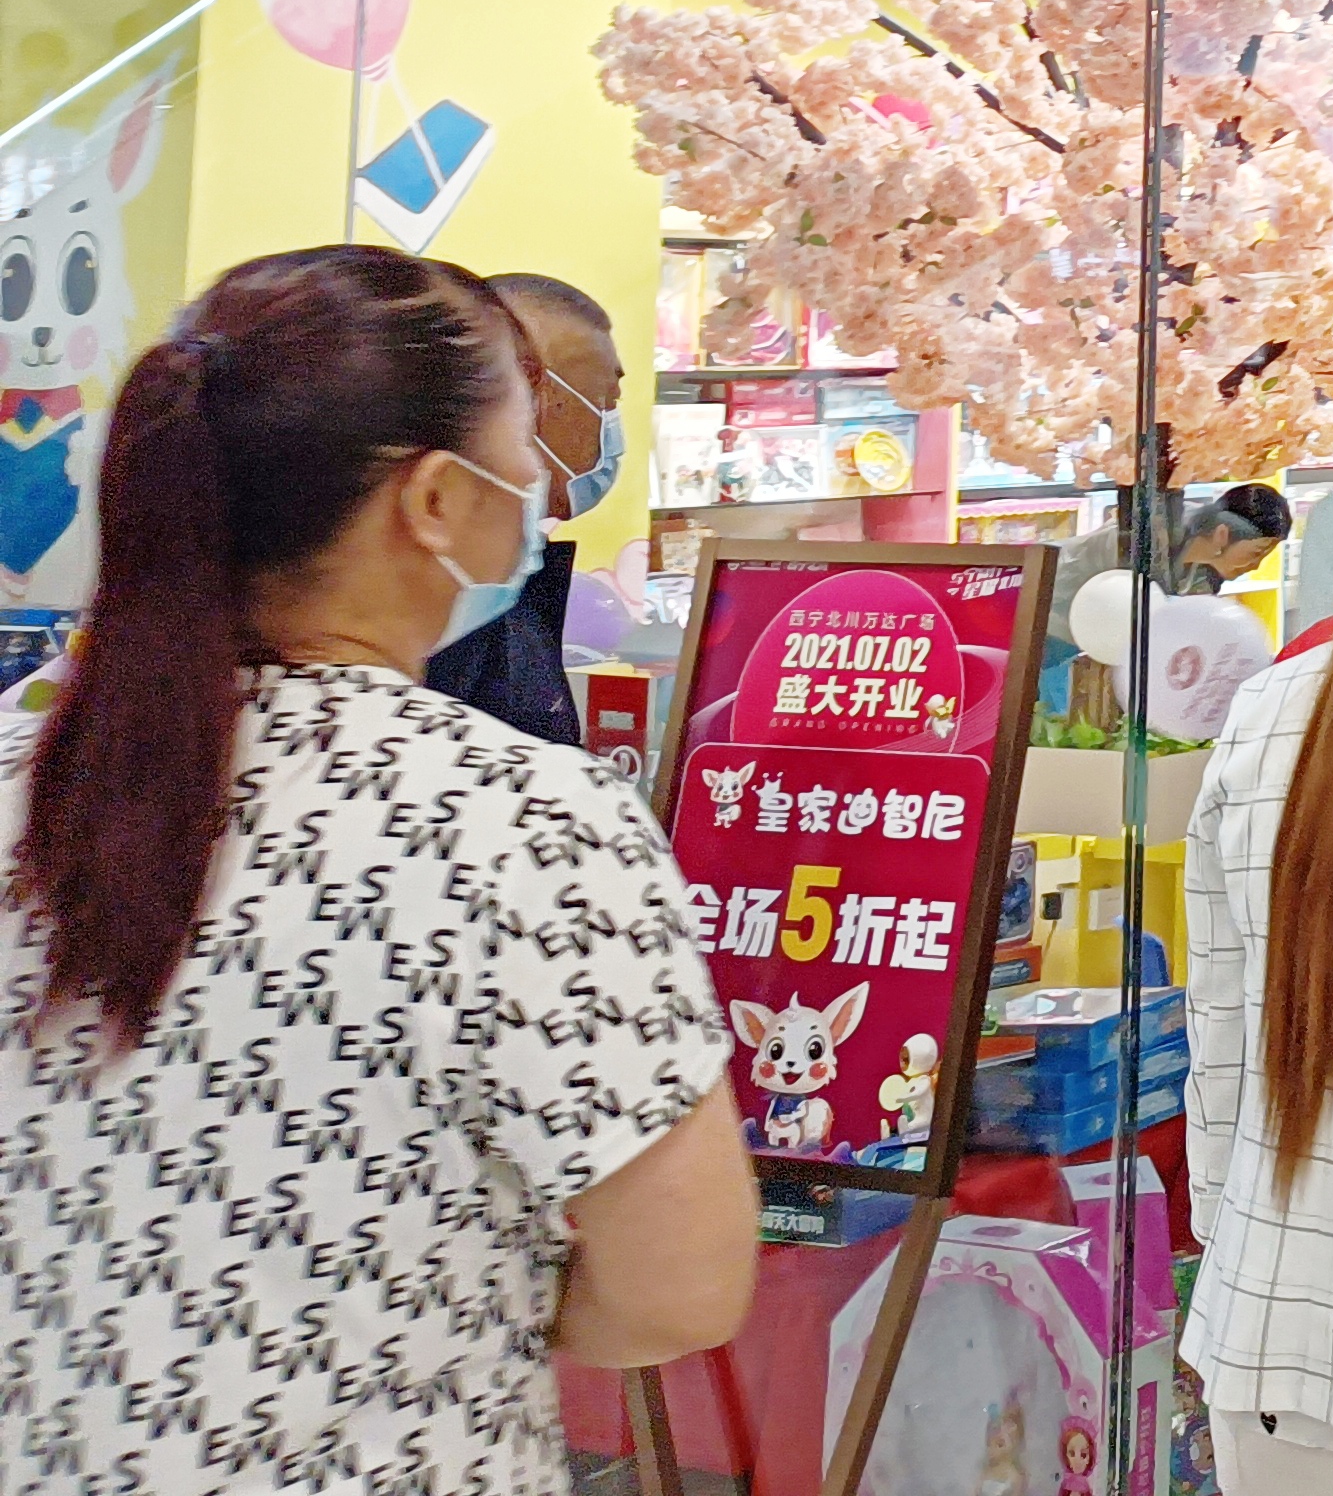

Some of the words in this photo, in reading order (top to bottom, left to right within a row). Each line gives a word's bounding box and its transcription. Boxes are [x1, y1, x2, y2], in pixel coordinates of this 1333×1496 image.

[788, 609, 936, 631] 西宁北川万达广场
[780, 632, 932, 674] 2021.07.02
[772, 673, 924, 719] 盛大开业
[752, 770, 965, 841] 皇家迪智尼
[682, 864, 956, 972] 全场5折起
